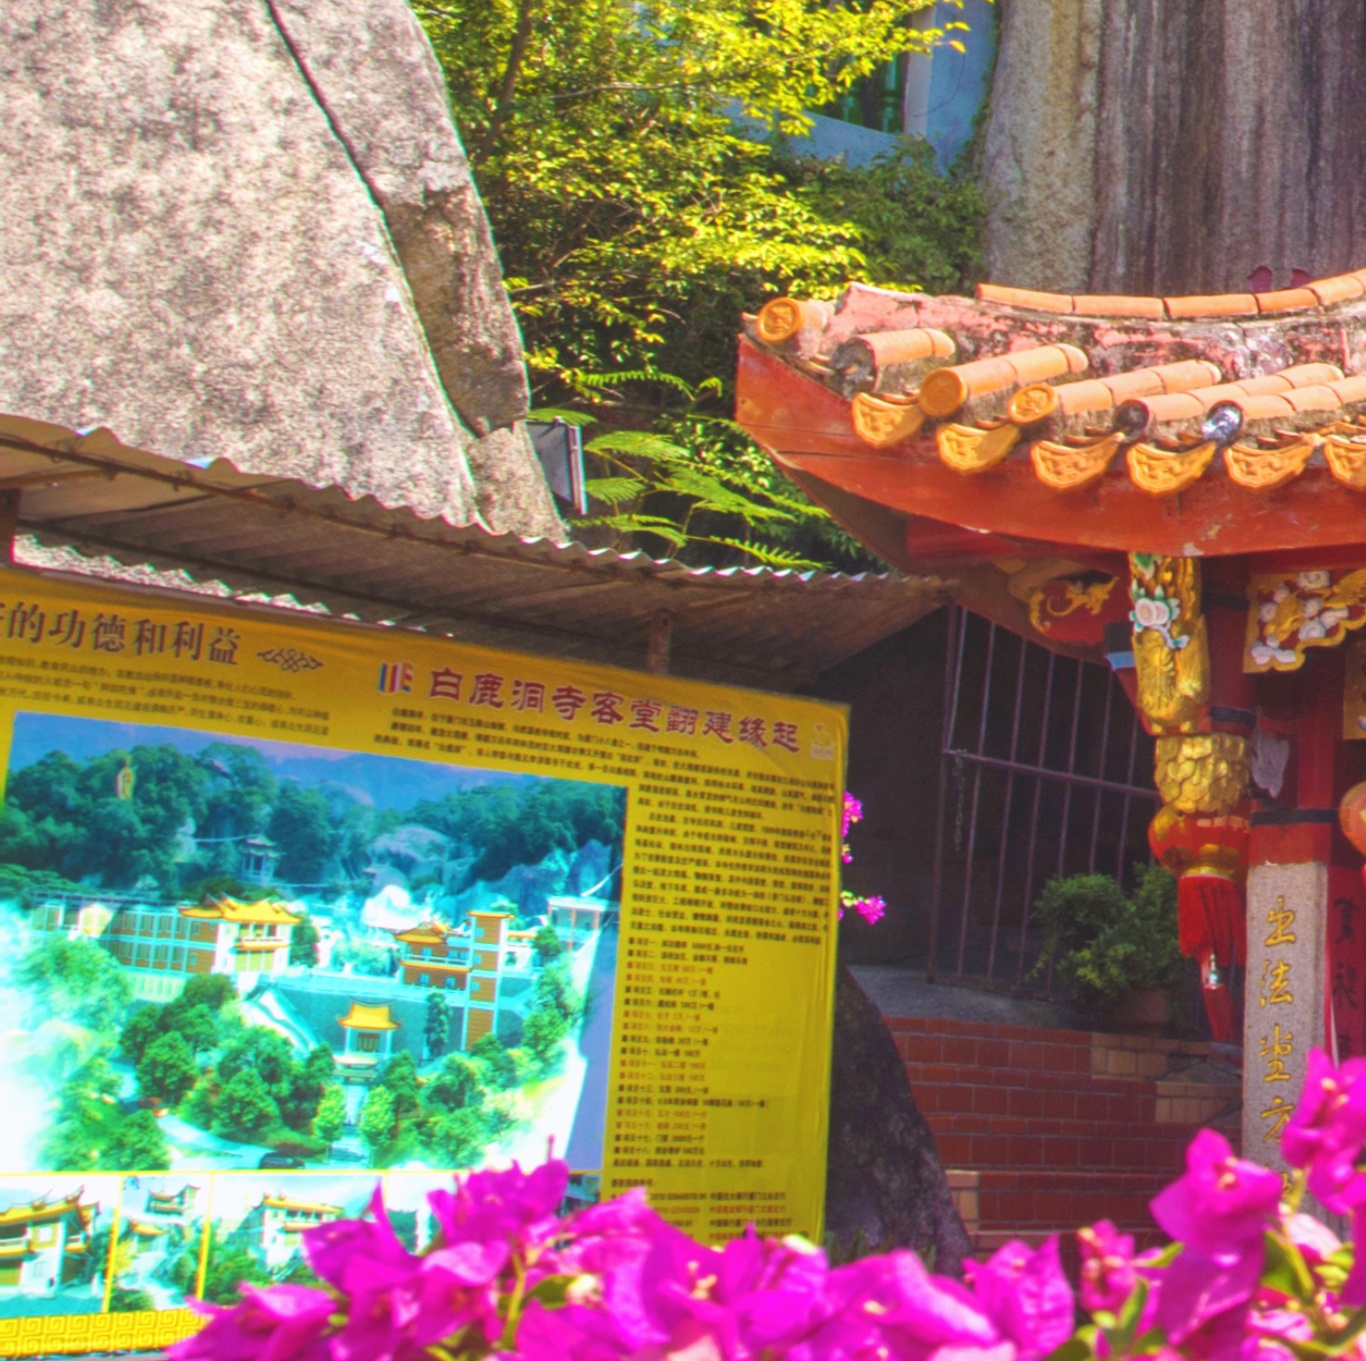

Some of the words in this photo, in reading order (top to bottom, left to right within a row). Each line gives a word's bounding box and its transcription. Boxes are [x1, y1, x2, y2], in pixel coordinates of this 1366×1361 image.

[0, 600, 242, 666] 的功德和利益
[429, 666, 801, 754] 白鹿洞寺客堂翻建缘起
